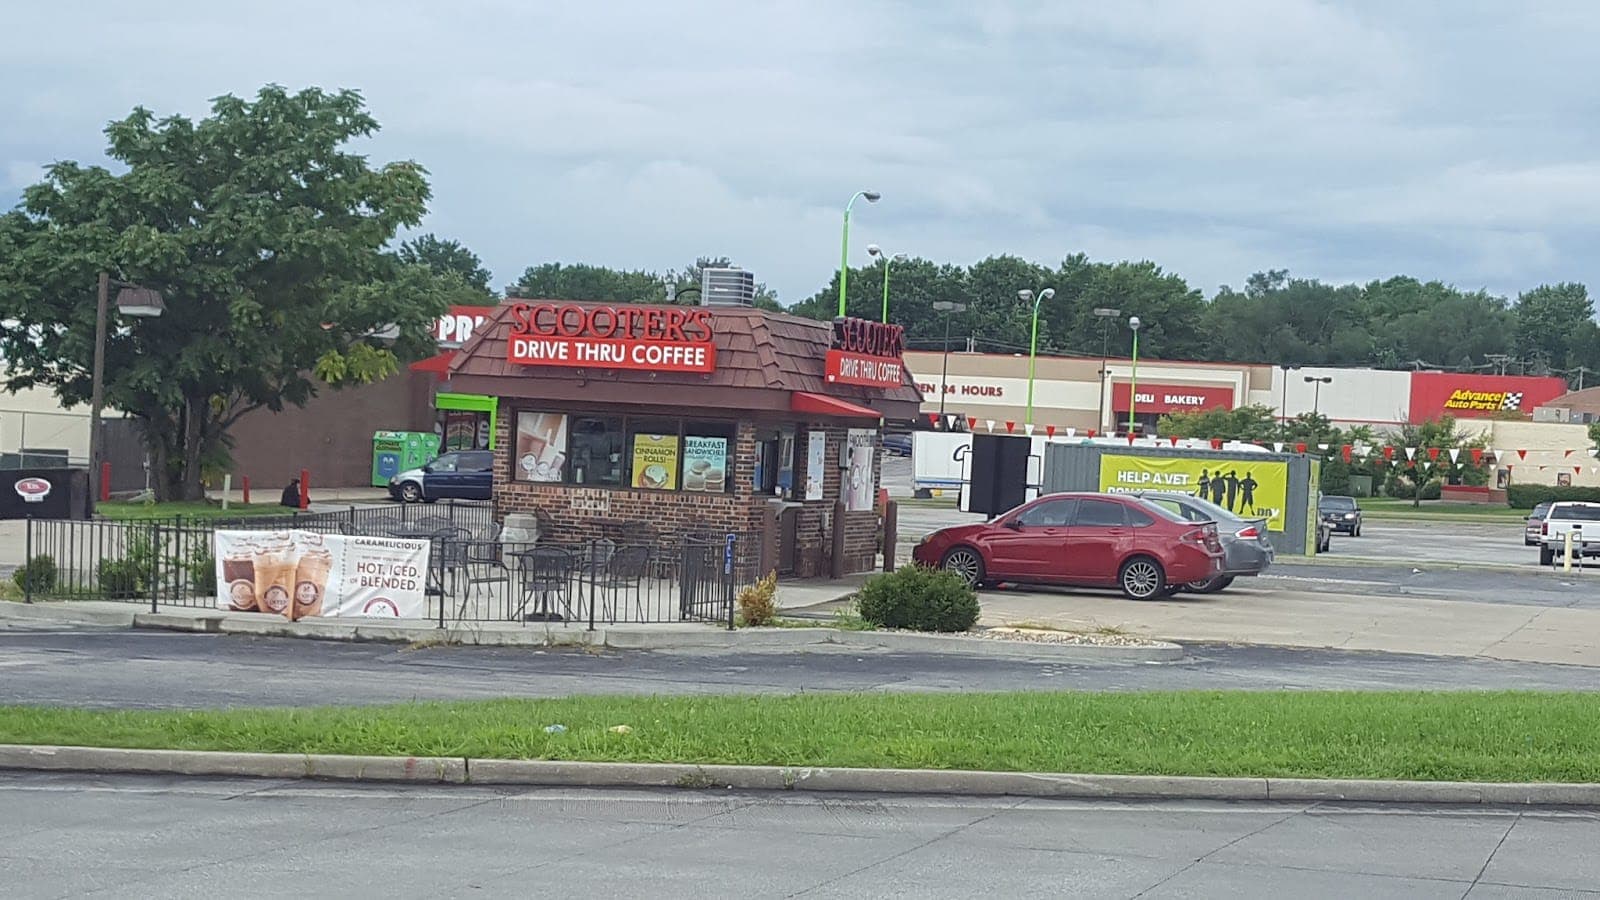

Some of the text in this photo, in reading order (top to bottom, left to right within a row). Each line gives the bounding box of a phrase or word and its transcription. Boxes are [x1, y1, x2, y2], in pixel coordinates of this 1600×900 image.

[510, 303, 713, 342] SCOOTER'S
[514, 340, 705, 366] DRIVE THRU COFFEE
[840, 358, 901, 383] DRIVE THRU COFFEE
[961, 385, 1003, 397] HOURS
[1450, 389, 1501, 402] Advance
[1135, 393, 1206, 406] DELI BAKERY
[1444, 399, 1497, 410] Auto Parts
[635, 447, 676, 456] CINNAMON
[1117, 470, 1190, 486] HELP A VET
[354, 538, 422, 551] CARAMELICIOUS
[356, 561, 420, 579] HOT. ICED.
[361, 575, 420, 592] BLENDED.
